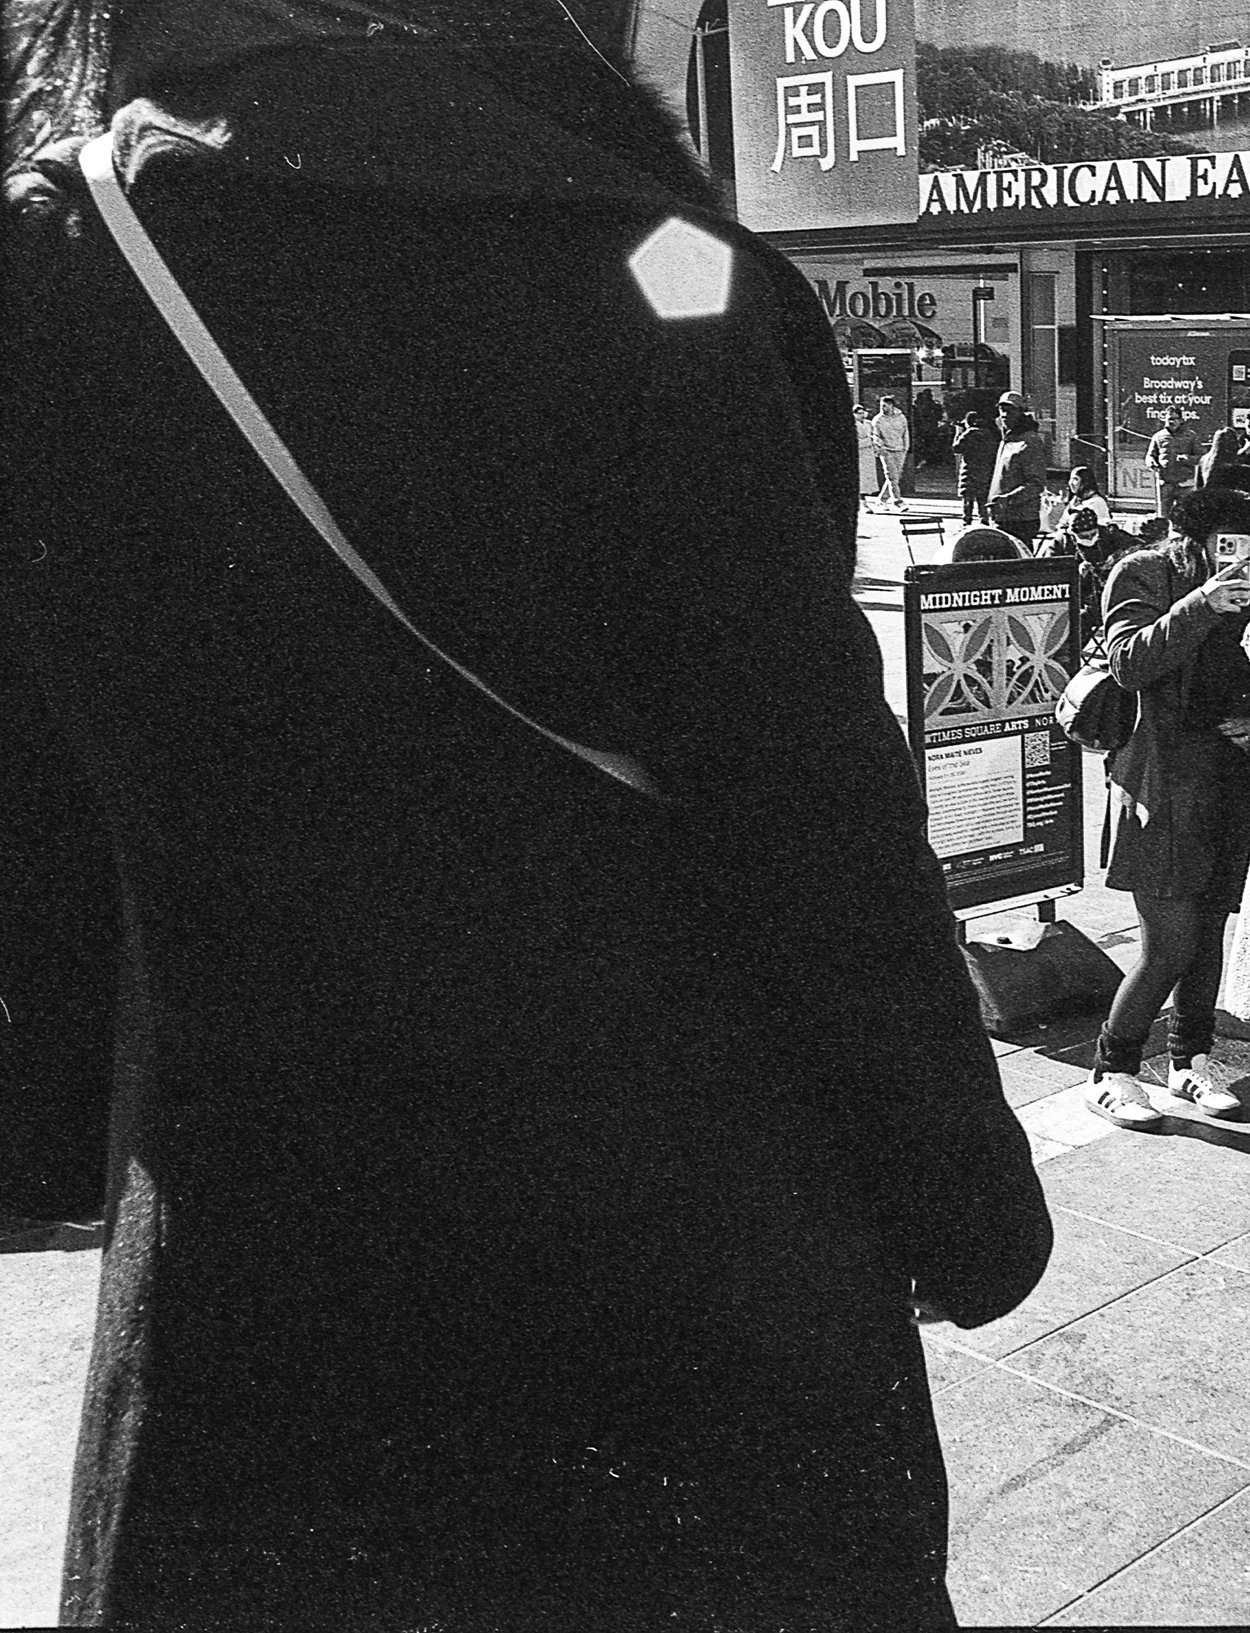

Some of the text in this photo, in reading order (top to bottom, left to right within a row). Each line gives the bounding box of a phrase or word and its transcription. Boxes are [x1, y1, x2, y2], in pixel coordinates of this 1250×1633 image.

[784, 0, 887, 63] KOU
[770, 68, 907, 173] 周口
[922, 158, 1171, 213] AMERICAN
[814, 279, 938, 319] Mobile
[1134, 391, 1213, 407] best tix at your
[1143, 376, 1203, 391] Broadway's
[920, 583, 1070, 610] MIDNIGHT MOMENT
[930, 728, 963, 743] TIMES
[964, 722, 1002, 738] SQUARE
[1004, 719, 1029, 732] ARTS
